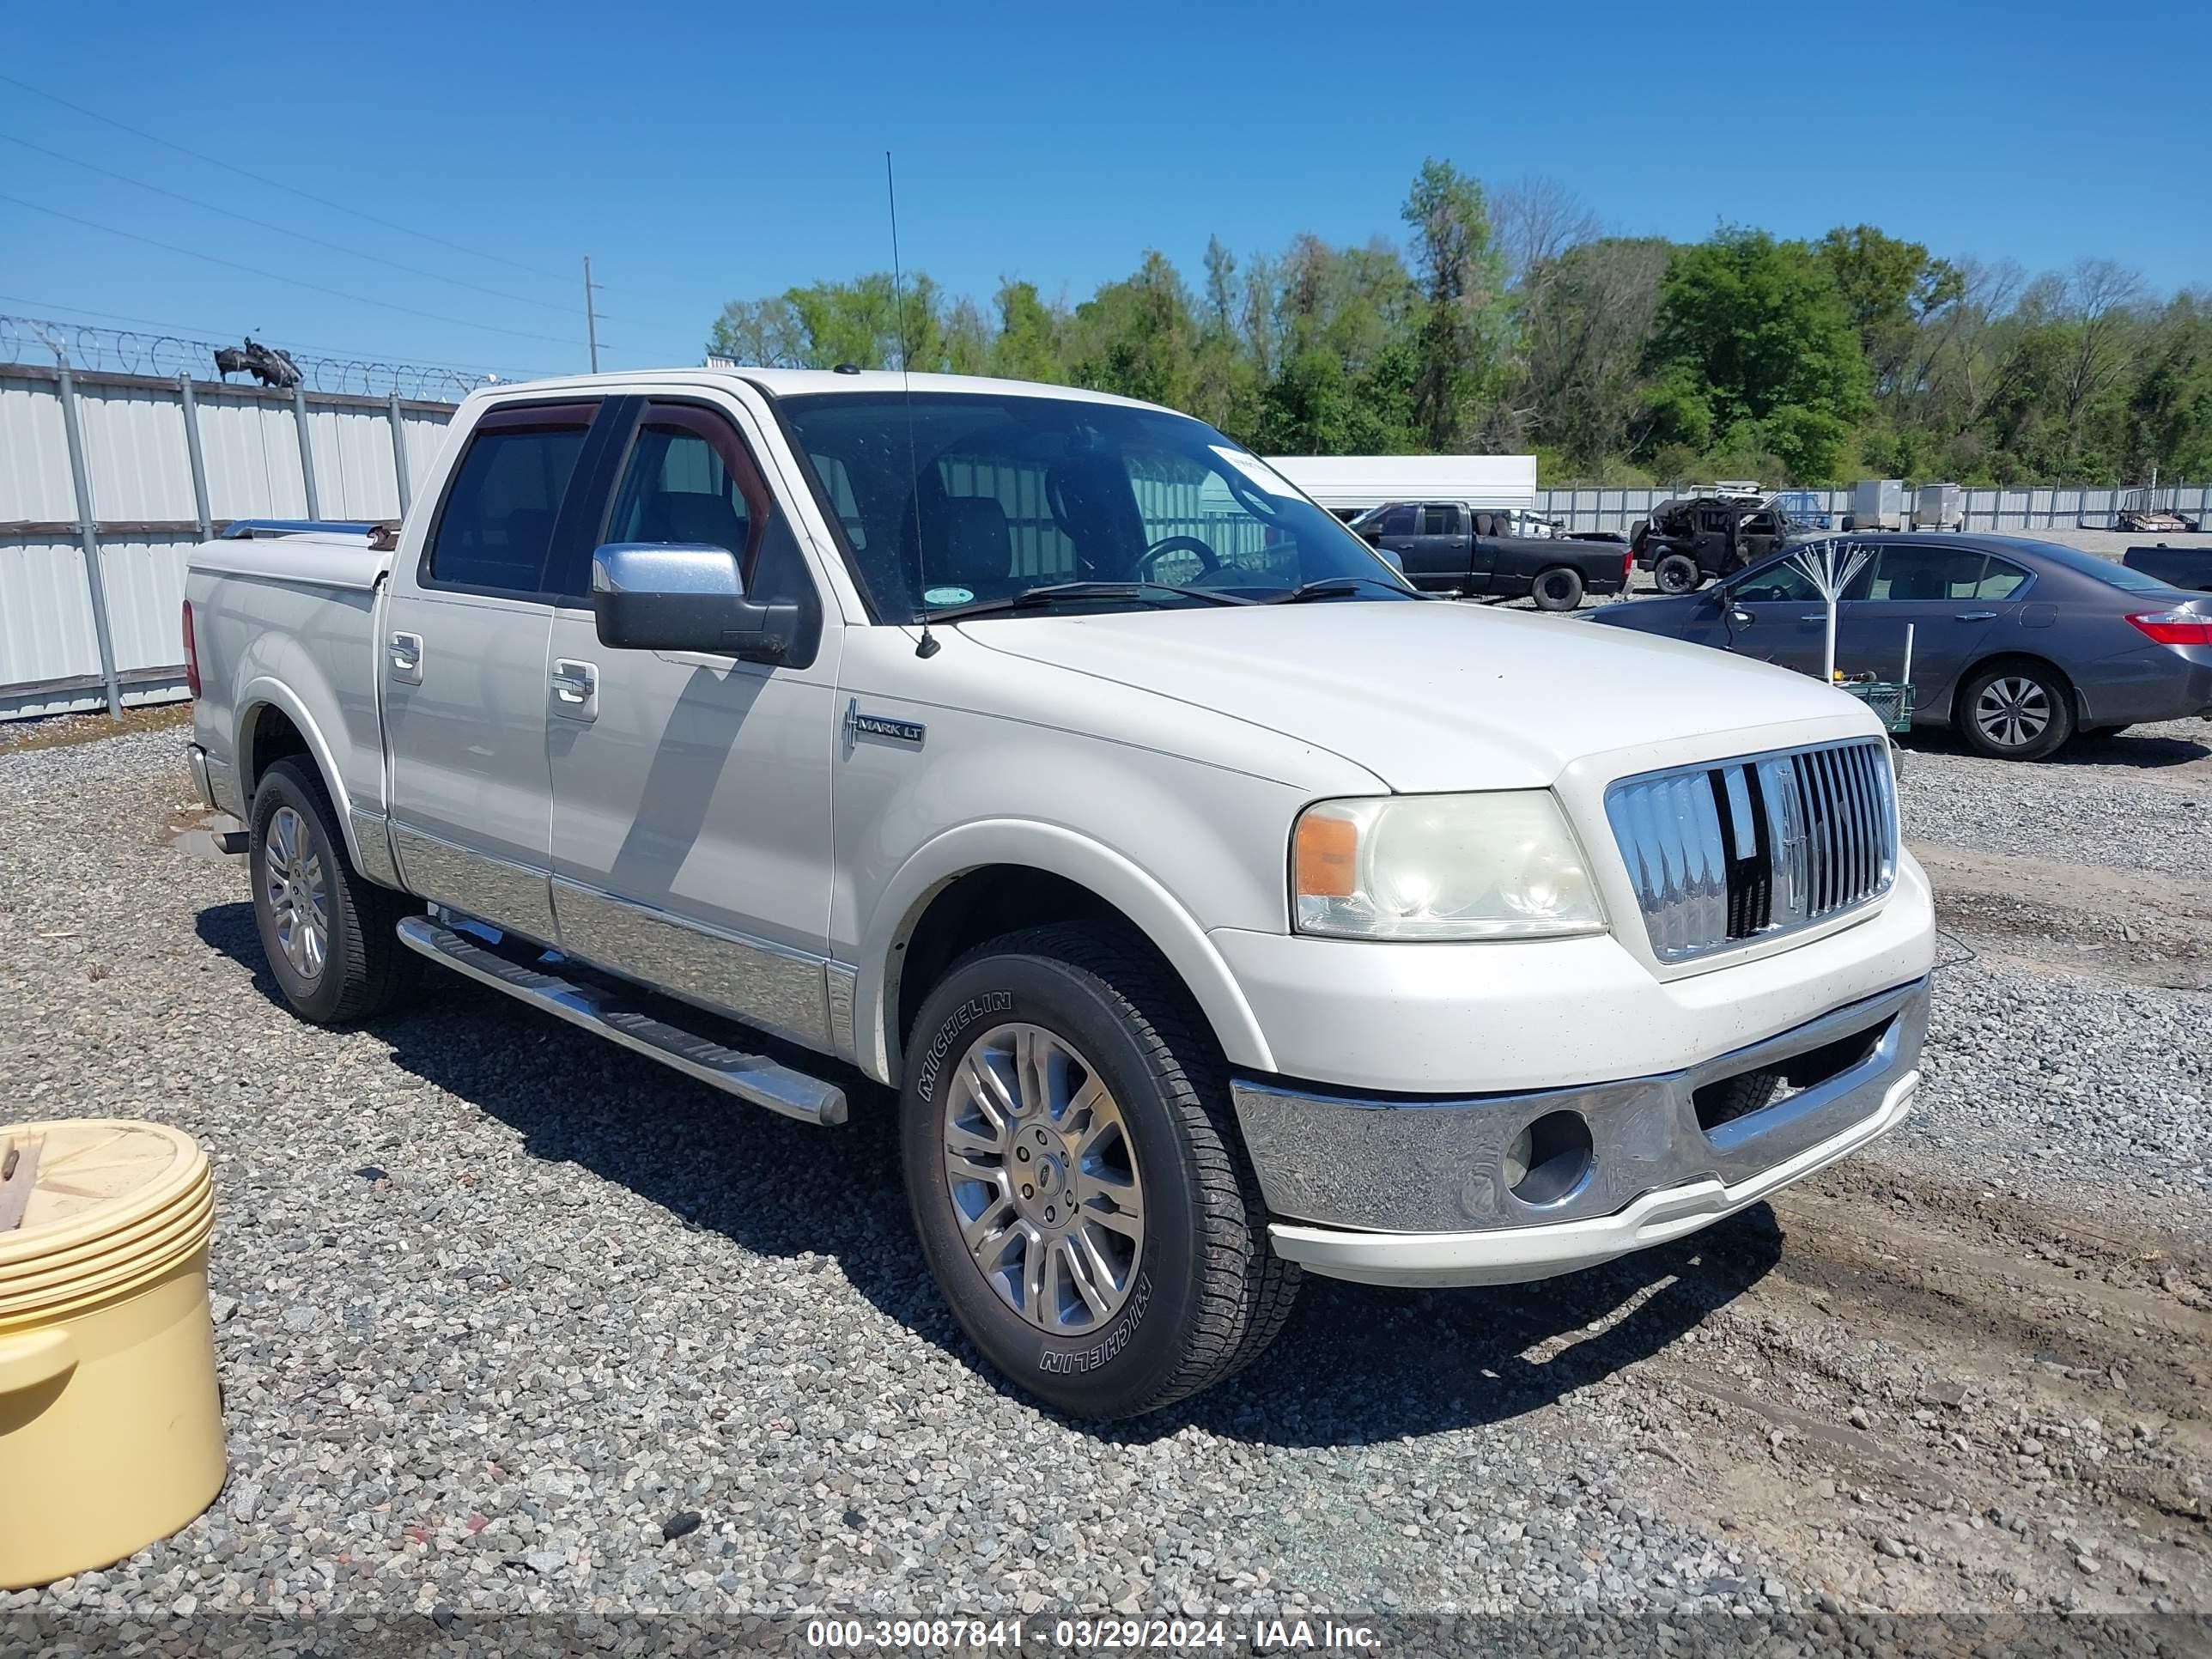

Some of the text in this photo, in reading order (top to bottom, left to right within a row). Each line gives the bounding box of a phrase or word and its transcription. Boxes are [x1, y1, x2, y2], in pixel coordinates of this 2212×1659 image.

[859, 718, 921, 738] MARK LT
[917, 991, 1012, 1103] MICHELIN
[1039, 1271, 1153, 1374] MICHELIN
